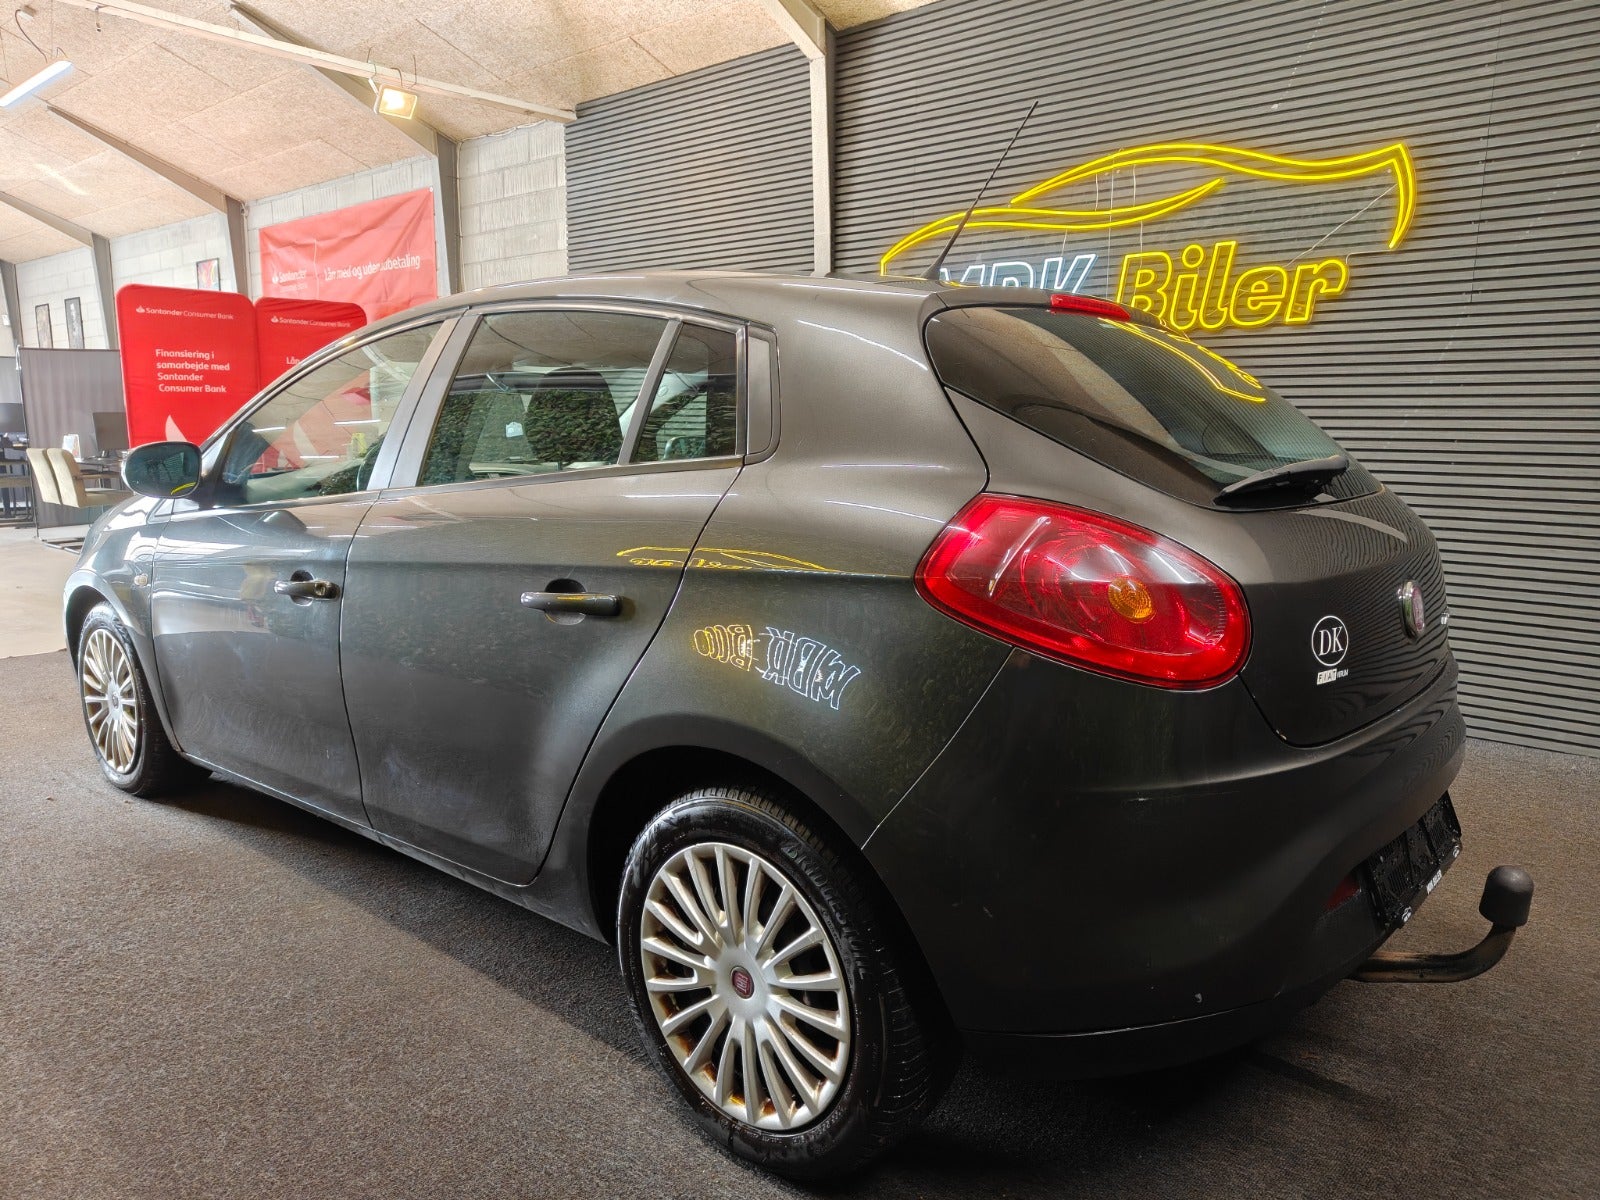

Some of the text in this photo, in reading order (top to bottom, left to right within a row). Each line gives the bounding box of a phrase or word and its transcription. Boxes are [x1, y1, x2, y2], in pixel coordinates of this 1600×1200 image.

[1116, 240, 1347, 330] Biler
[145, 307, 234, 320] Santander Consumer Bank
[279, 317, 308, 325] Santander
[155, 349, 210, 360] Finansiering
[156, 361, 230, 371] samarbejde med
[157, 372, 204, 381] Santander
[158, 384, 227, 393] Consumer Bank
[1319, 626, 1344, 656] DK
[1317, 668, 1337, 685] FIAT
